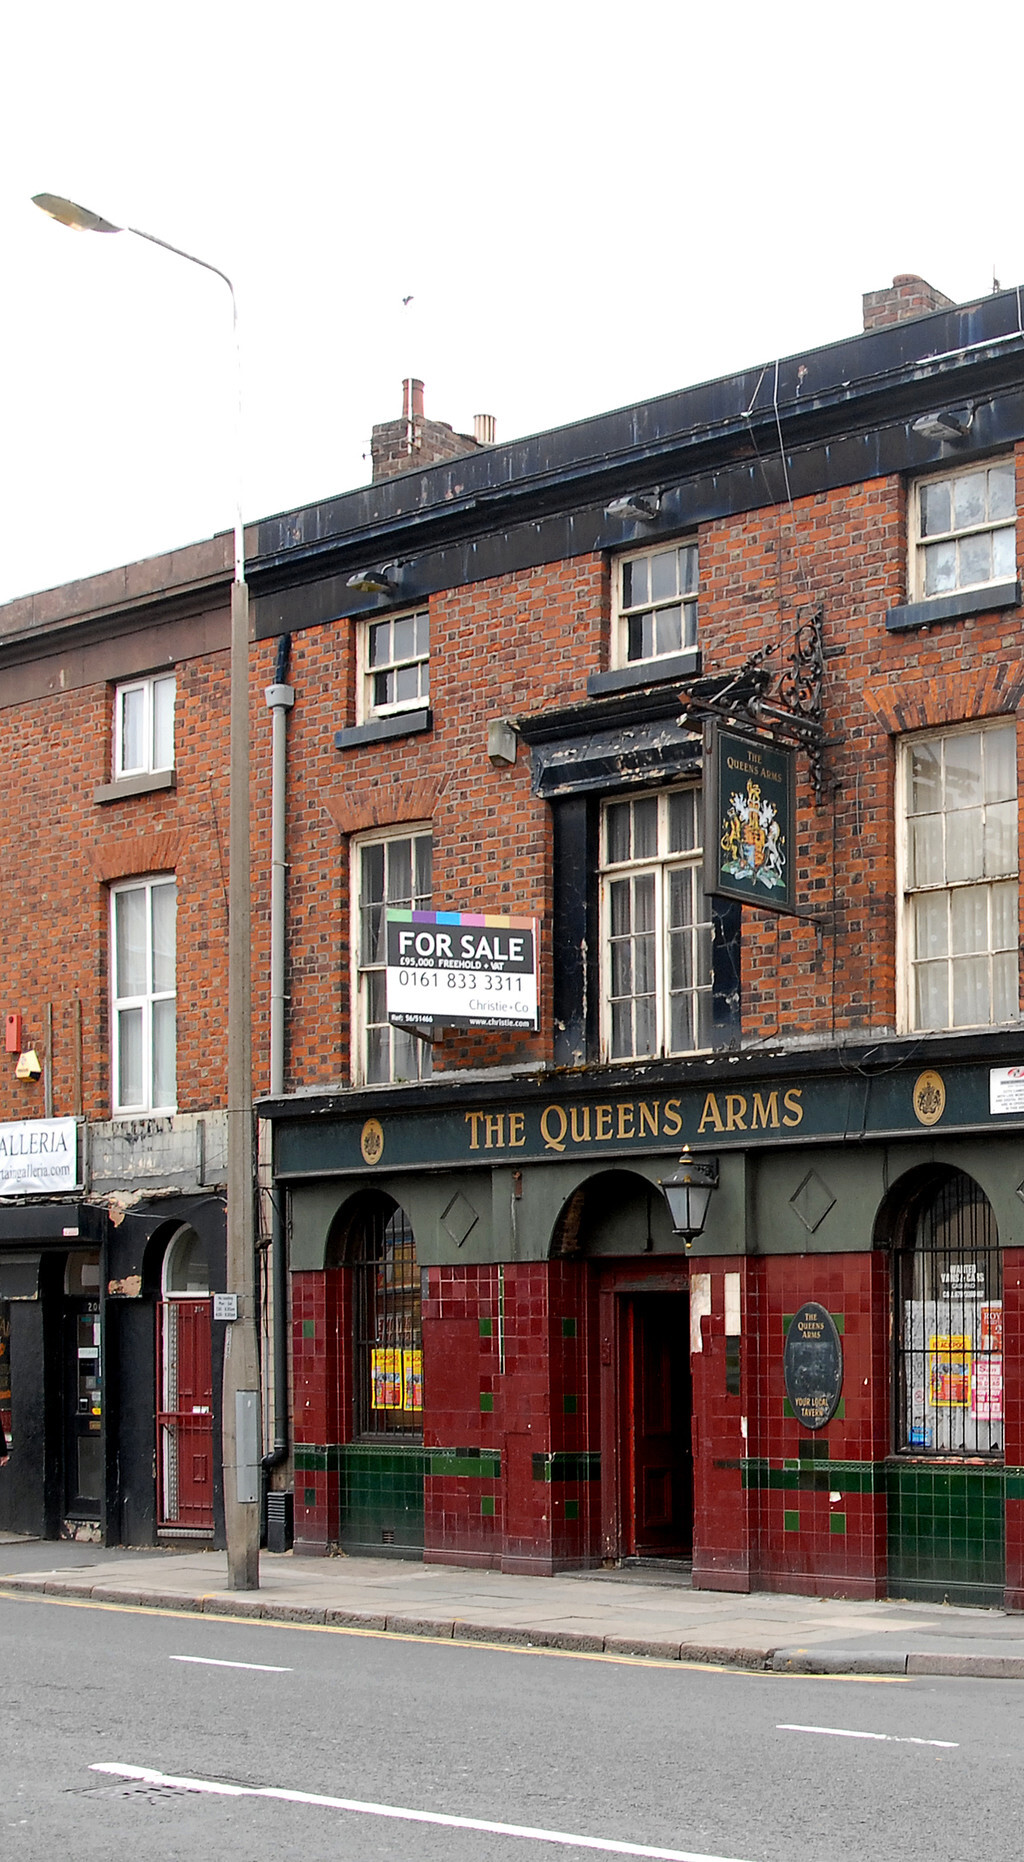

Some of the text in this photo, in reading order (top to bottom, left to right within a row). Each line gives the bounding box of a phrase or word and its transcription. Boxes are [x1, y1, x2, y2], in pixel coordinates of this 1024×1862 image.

[747, 751, 762, 764] THE
[727, 757, 782, 783] QUEENS ARMS
[399, 931, 524, 962] FOR SALE
[400, 957, 434, 967] £95,000
[438, 958, 482, 970] FREEHOLD
[491, 962, 504, 971] VAT
[399, 970, 522, 992] 0161 833 3311
[469, 999, 508, 1012] Christie
[469, 1018, 530, 1028] www.christie.com
[464, 1089, 803, 1151] THE QUEENS ARMS
[804, 1312, 818, 1321] THE
[797, 1322, 825, 1331] QUEENS
[801, 1331, 821, 1339] ARMS
